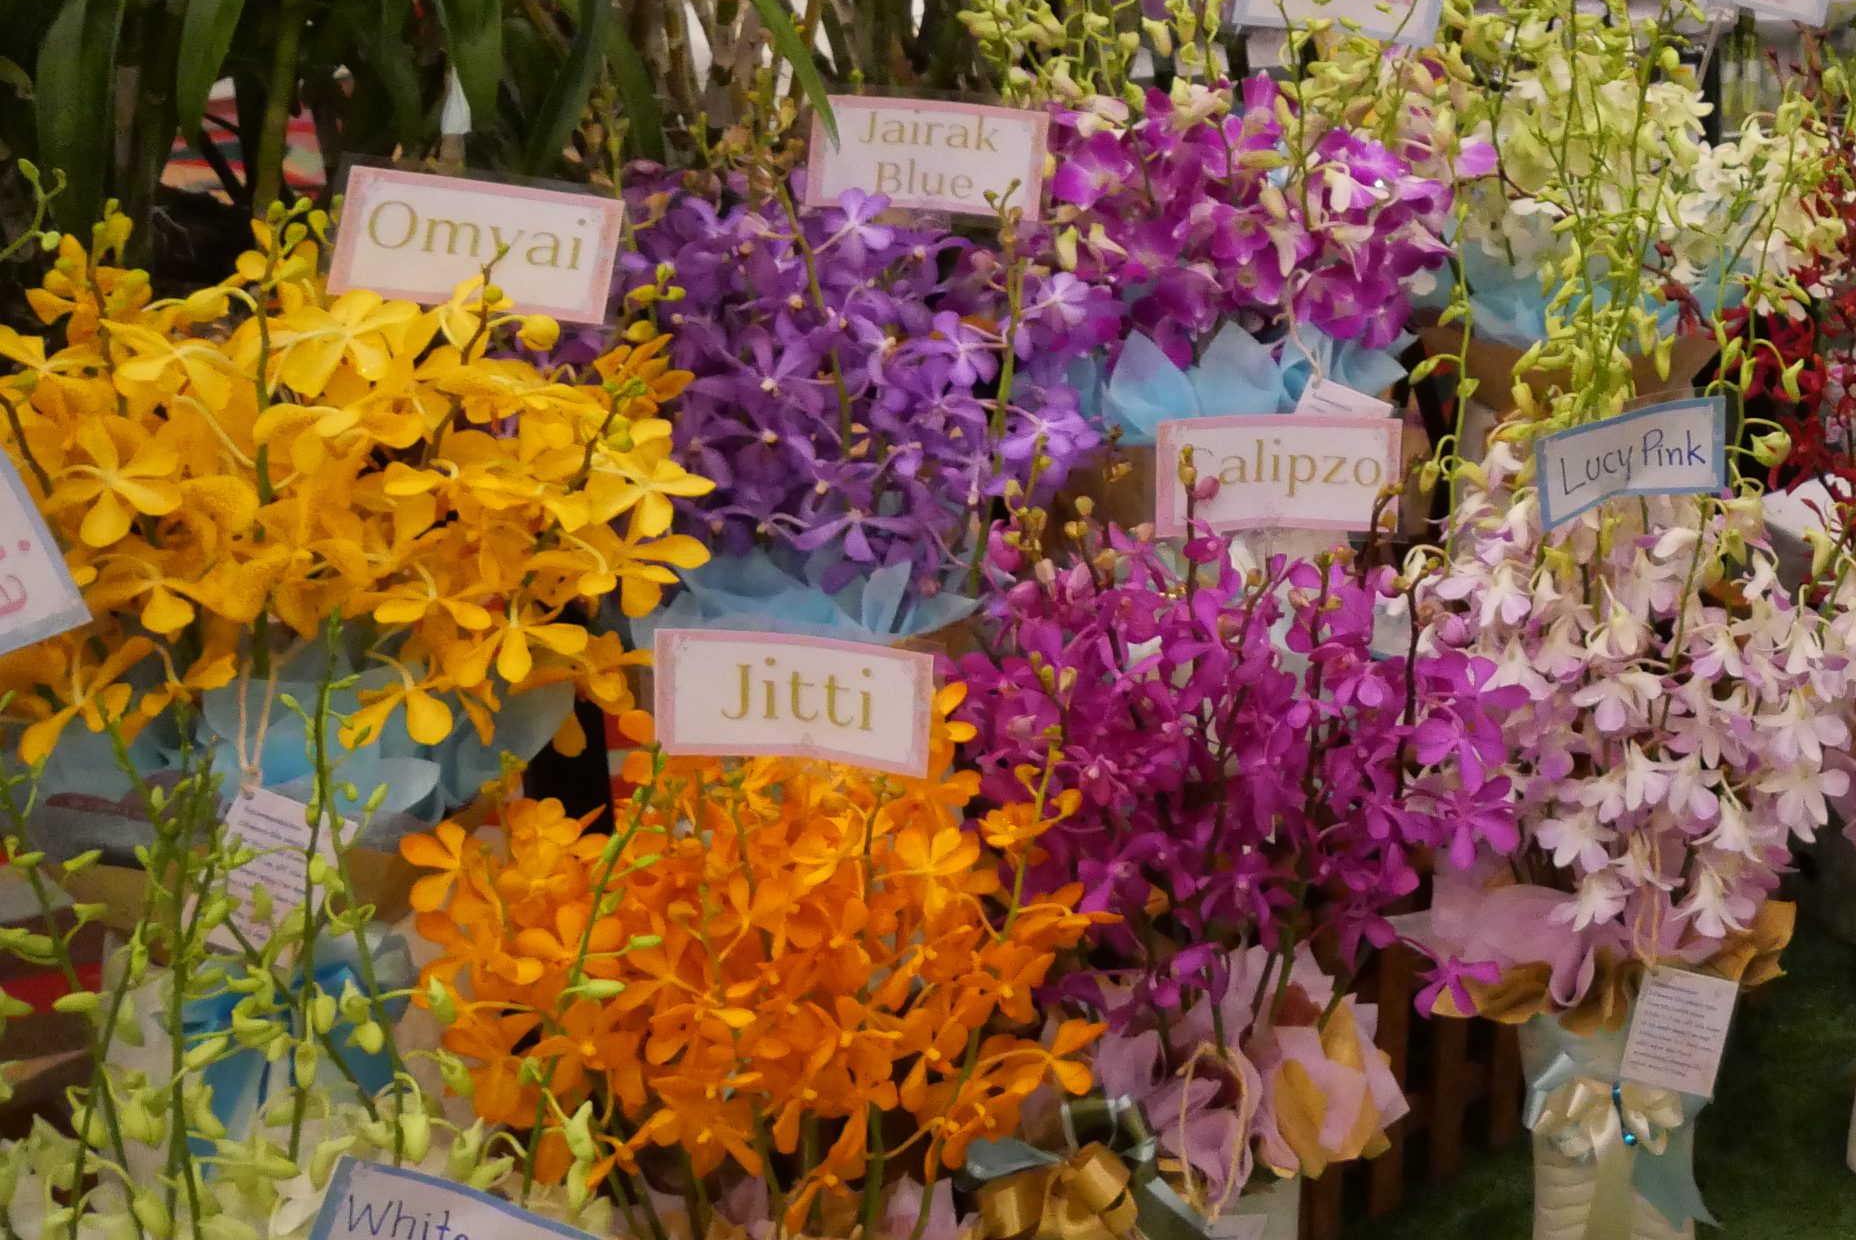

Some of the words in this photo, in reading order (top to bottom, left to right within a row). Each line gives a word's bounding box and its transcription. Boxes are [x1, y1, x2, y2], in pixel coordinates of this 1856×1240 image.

[859, 109, 1000, 153] Jairak
[874, 158, 974, 199] Blue
[367, 200, 587, 270] Omyai
[1642, 428, 1706, 467] Pink
[720, 656, 875, 731] Jitti
